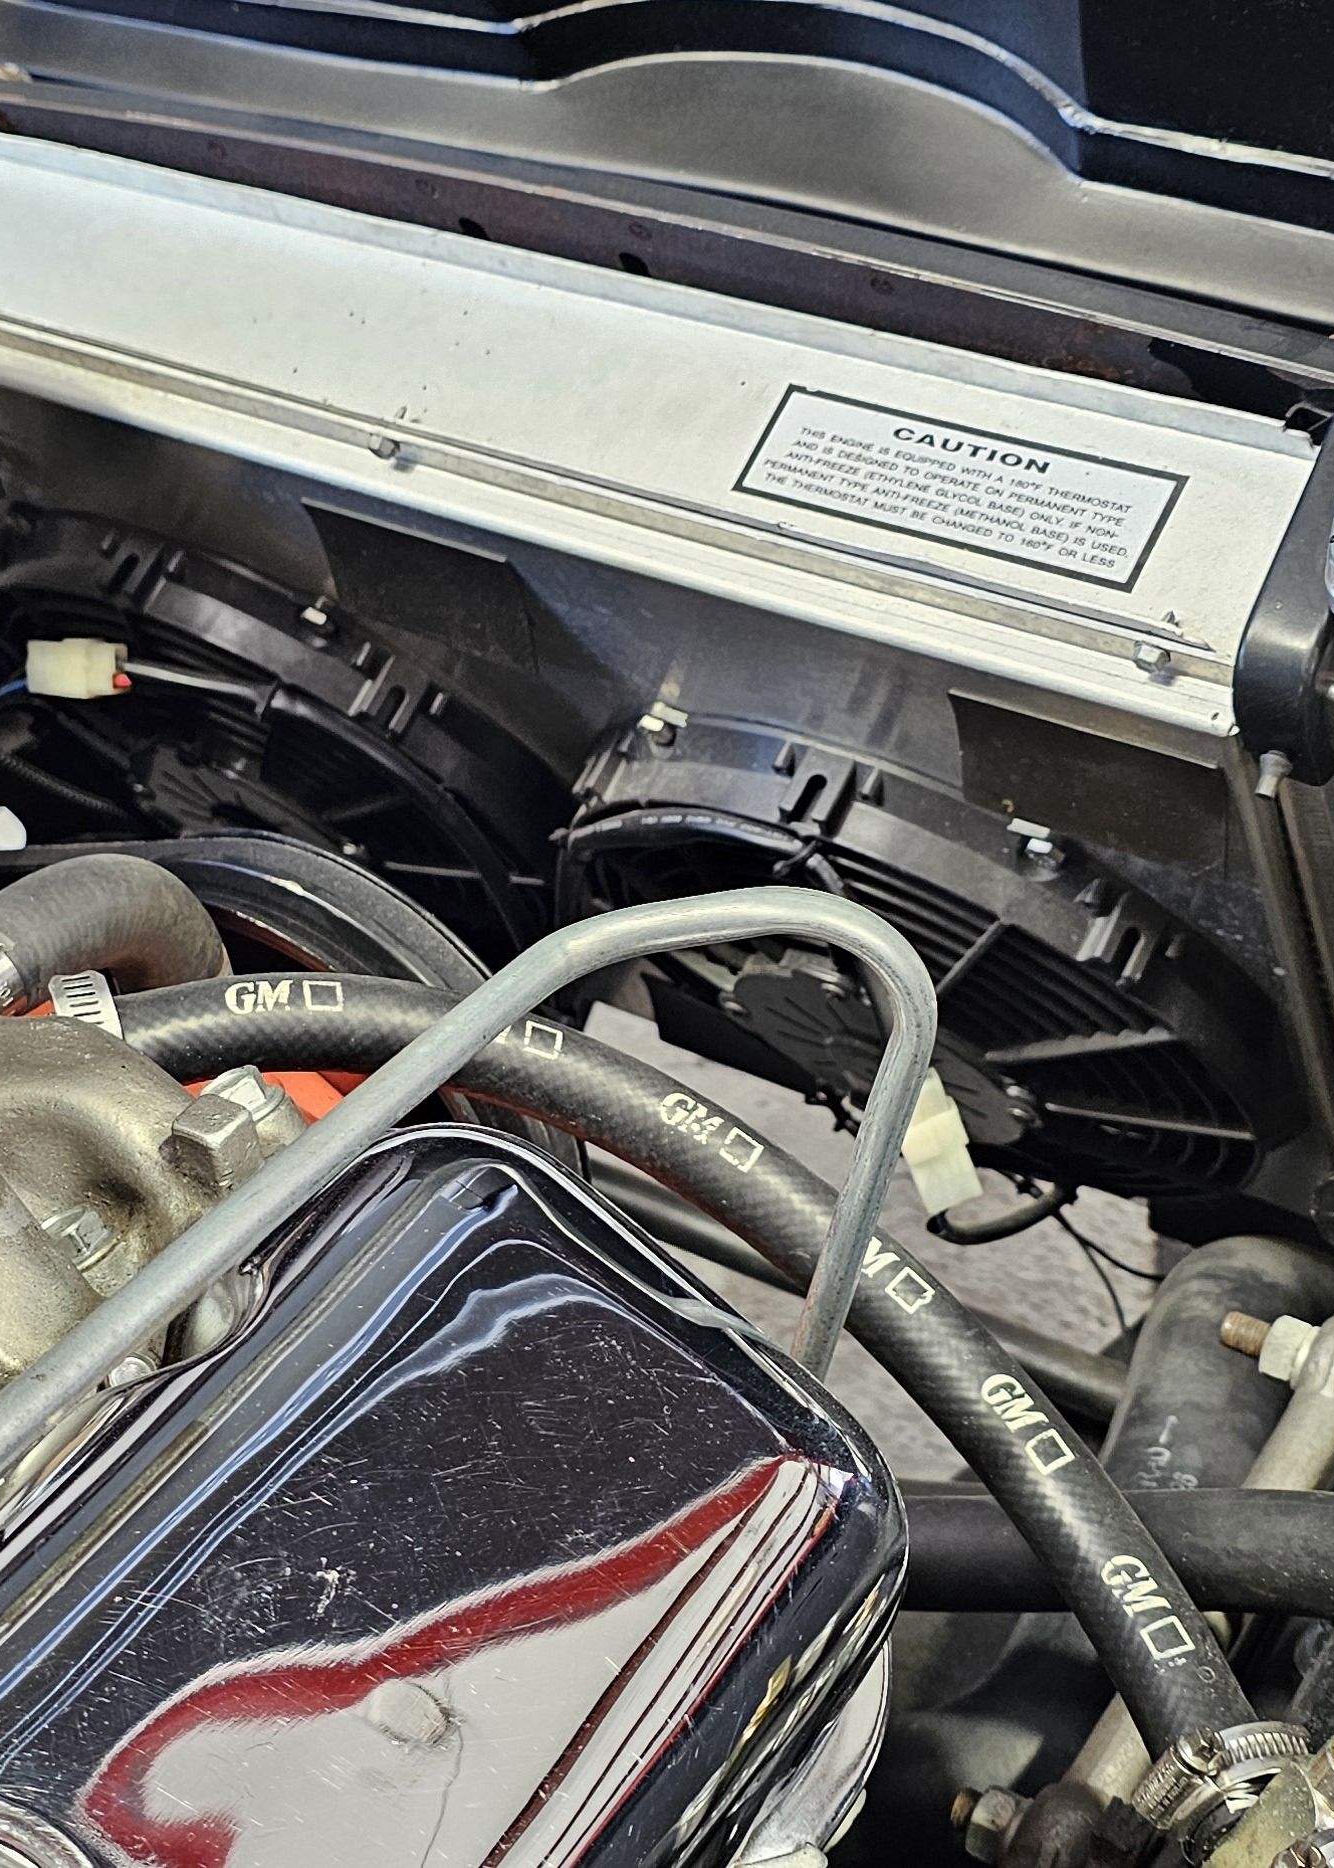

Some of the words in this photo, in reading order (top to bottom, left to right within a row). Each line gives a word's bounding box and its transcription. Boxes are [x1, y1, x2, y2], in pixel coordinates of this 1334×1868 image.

[802, 427, 826, 439] THIS
[830, 435, 874, 451] ENGINE
[878, 447, 891, 455] IS
[894, 450, 956, 471] EQUIPPED
[961, 467, 993, 480] WITH
[995, 475, 1003, 483] A
[1048, 487, 1132, 513] THERMOSTAT
[894, 428, 1051, 474] CAUTION
[764, 459, 835, 482] PERMANENT
[839, 477, 868, 491] TYPE
[872, 487, 950, 512] ANTI-FREEZE
[954, 508, 1024, 532] (METHANOL
[1030, 526, 1069, 543] BASE)
[1073, 537, 1087, 546] IS
[786, 452, 860, 475] ANTI-FREEZE
[864, 471, 931, 492] (ETHYLENE
[935, 488, 981, 507] GLYCOL
[987, 501, 1025, 518] BASE)
[1069, 521, 1082, 529] IF
[1086, 525, 1118, 539] NON-
[793, 440, 819, 451] AND
[822, 447, 834, 455] IS
[838, 450, 899, 471] DESIGNED
[904, 466, 920, 476] TO
[924, 472, 980, 491] OPERATE
[984, 486, 1004, 497] ON
[1008, 492, 1087, 516] PERMANENT
[1092, 512, 1125, 527] TYPE
[766, 472, 788, 486] THE
[794, 480, 869, 506] THERMOSTAT
[873, 501, 907, 514] MUST
[910, 510, 927, 521] BE
[932, 516, 993, 537] CHANGED
[998, 532, 1015, 543] TO
[1058, 547, 1078, 559] OR
[1082, 553, 1115, 568] LESS
[224, 979, 293, 1015] GM
[659, 1092, 725, 1145] GM
[861, 1236, 901, 1279] M
[981, 1373, 1050, 1434] GM
[1100, 1554, 1172, 1618] GM
